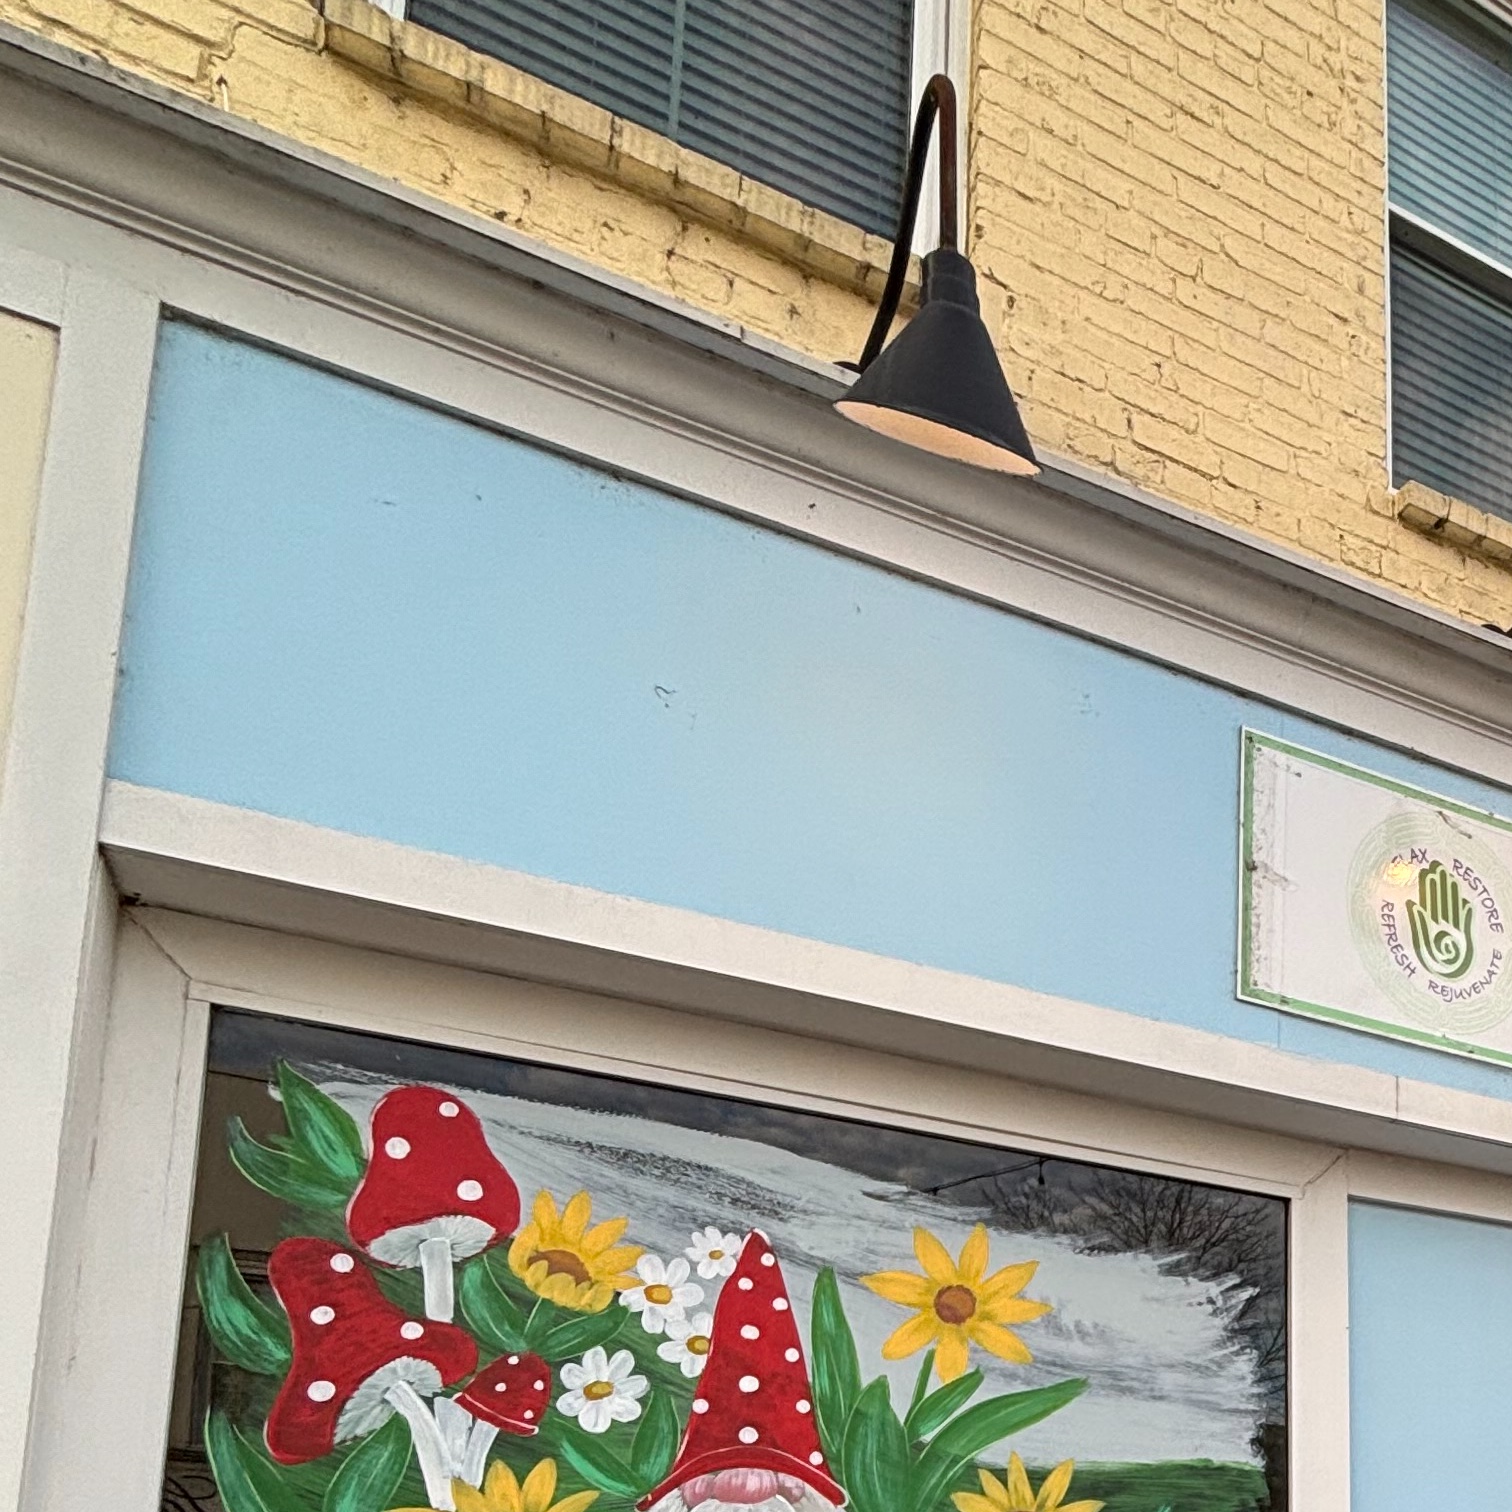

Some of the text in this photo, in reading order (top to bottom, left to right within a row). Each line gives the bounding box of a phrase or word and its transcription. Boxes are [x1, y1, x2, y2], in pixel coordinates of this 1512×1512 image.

[1452, 858, 1504, 934] RESTORE
[1380, 899, 1503, 1003] REFRESH REJUVENATE
